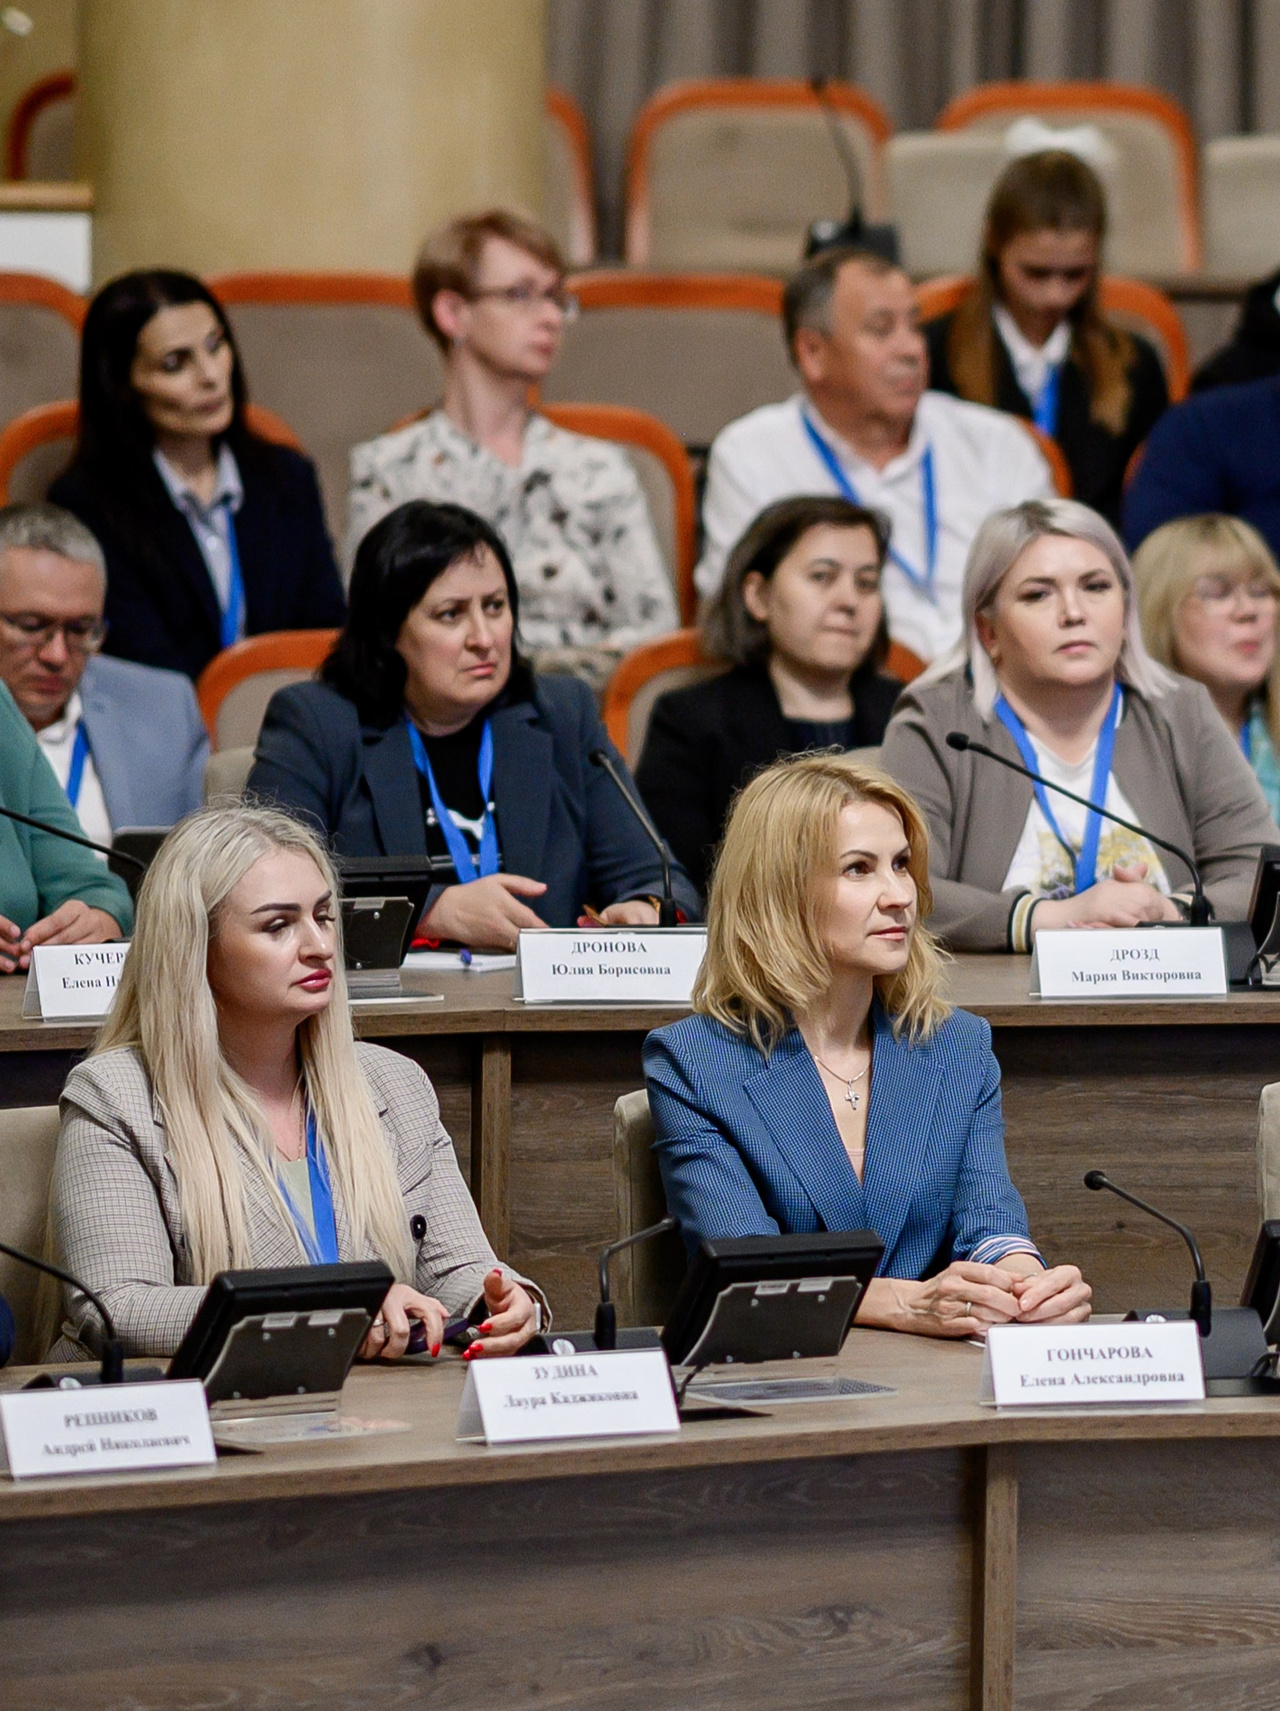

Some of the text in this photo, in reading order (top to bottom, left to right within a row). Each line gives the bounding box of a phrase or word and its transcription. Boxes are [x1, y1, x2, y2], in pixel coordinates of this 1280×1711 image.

[571, 941, 648, 954] ДРОНОВА
[1110, 949, 1160, 961] ДРОЗД
[74, 952, 127, 965] КУЧЕР
[551, 963, 671, 978] Юлия Борисовна
[1071, 969, 1202, 985] Мария Викторовна
[62, 976, 102, 989] Елена
[1046, 1346, 1153, 1362] ГОНЧАРОВА
[532, 1363, 599, 1380] ЗУДИНА
[1020, 1372, 1186, 1388] Елена Александровна
